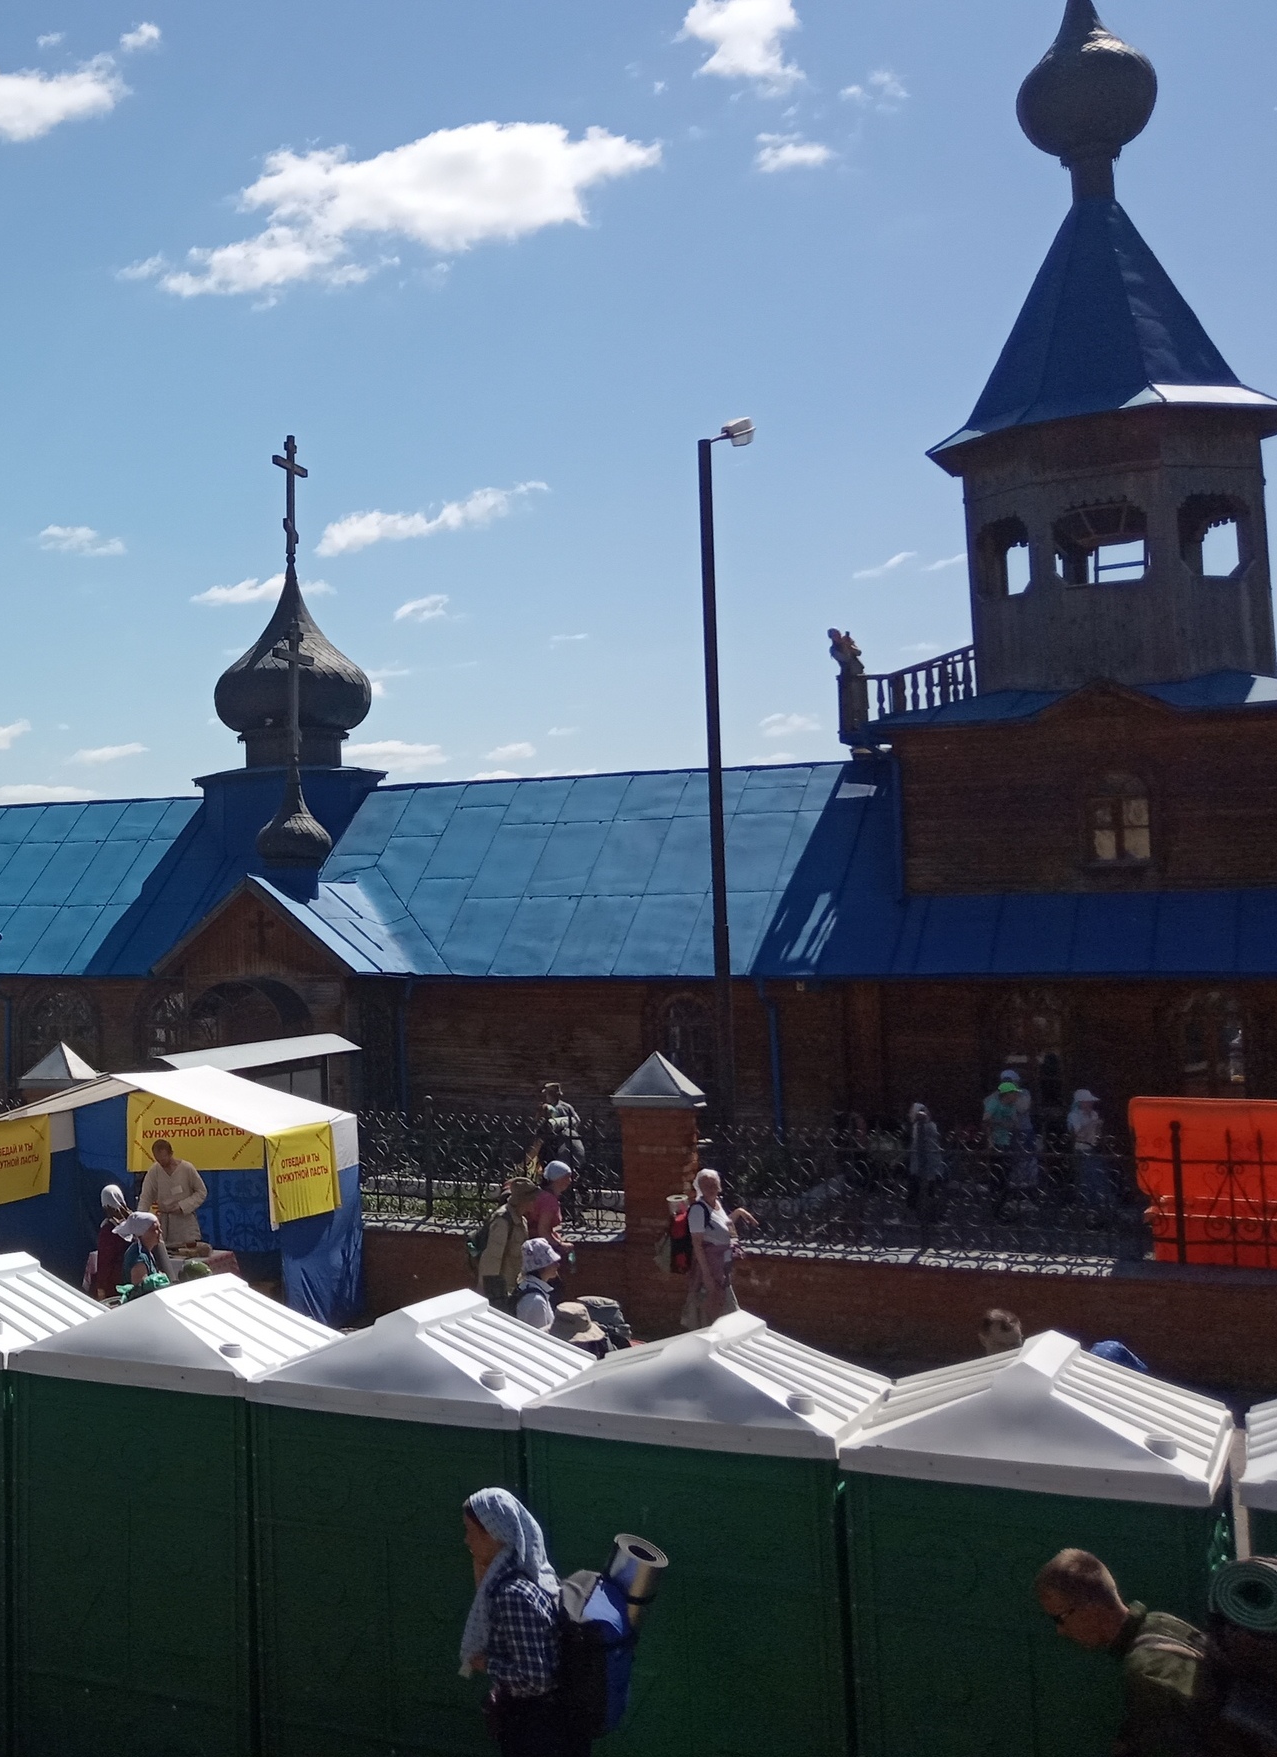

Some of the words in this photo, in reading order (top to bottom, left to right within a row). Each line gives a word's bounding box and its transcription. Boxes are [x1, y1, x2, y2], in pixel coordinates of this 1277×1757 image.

[154, 1114, 201, 1126] ОТВЕДАЙ
[205, 1116, 212, 1124] И
[142, 1126, 205, 1139] КУНЖУТНОЙ
[209, 1127, 245, 1137] ПАСТЫ
[18, 1145, 23, 1153] И
[24, 1142, 33, 1152] ТЫ
[20, 1154, 39, 1165] ПАСТЫ
[281, 1154, 306, 1169] ОТВЕДАЙ
[311, 1152, 320, 1162] ТЫ
